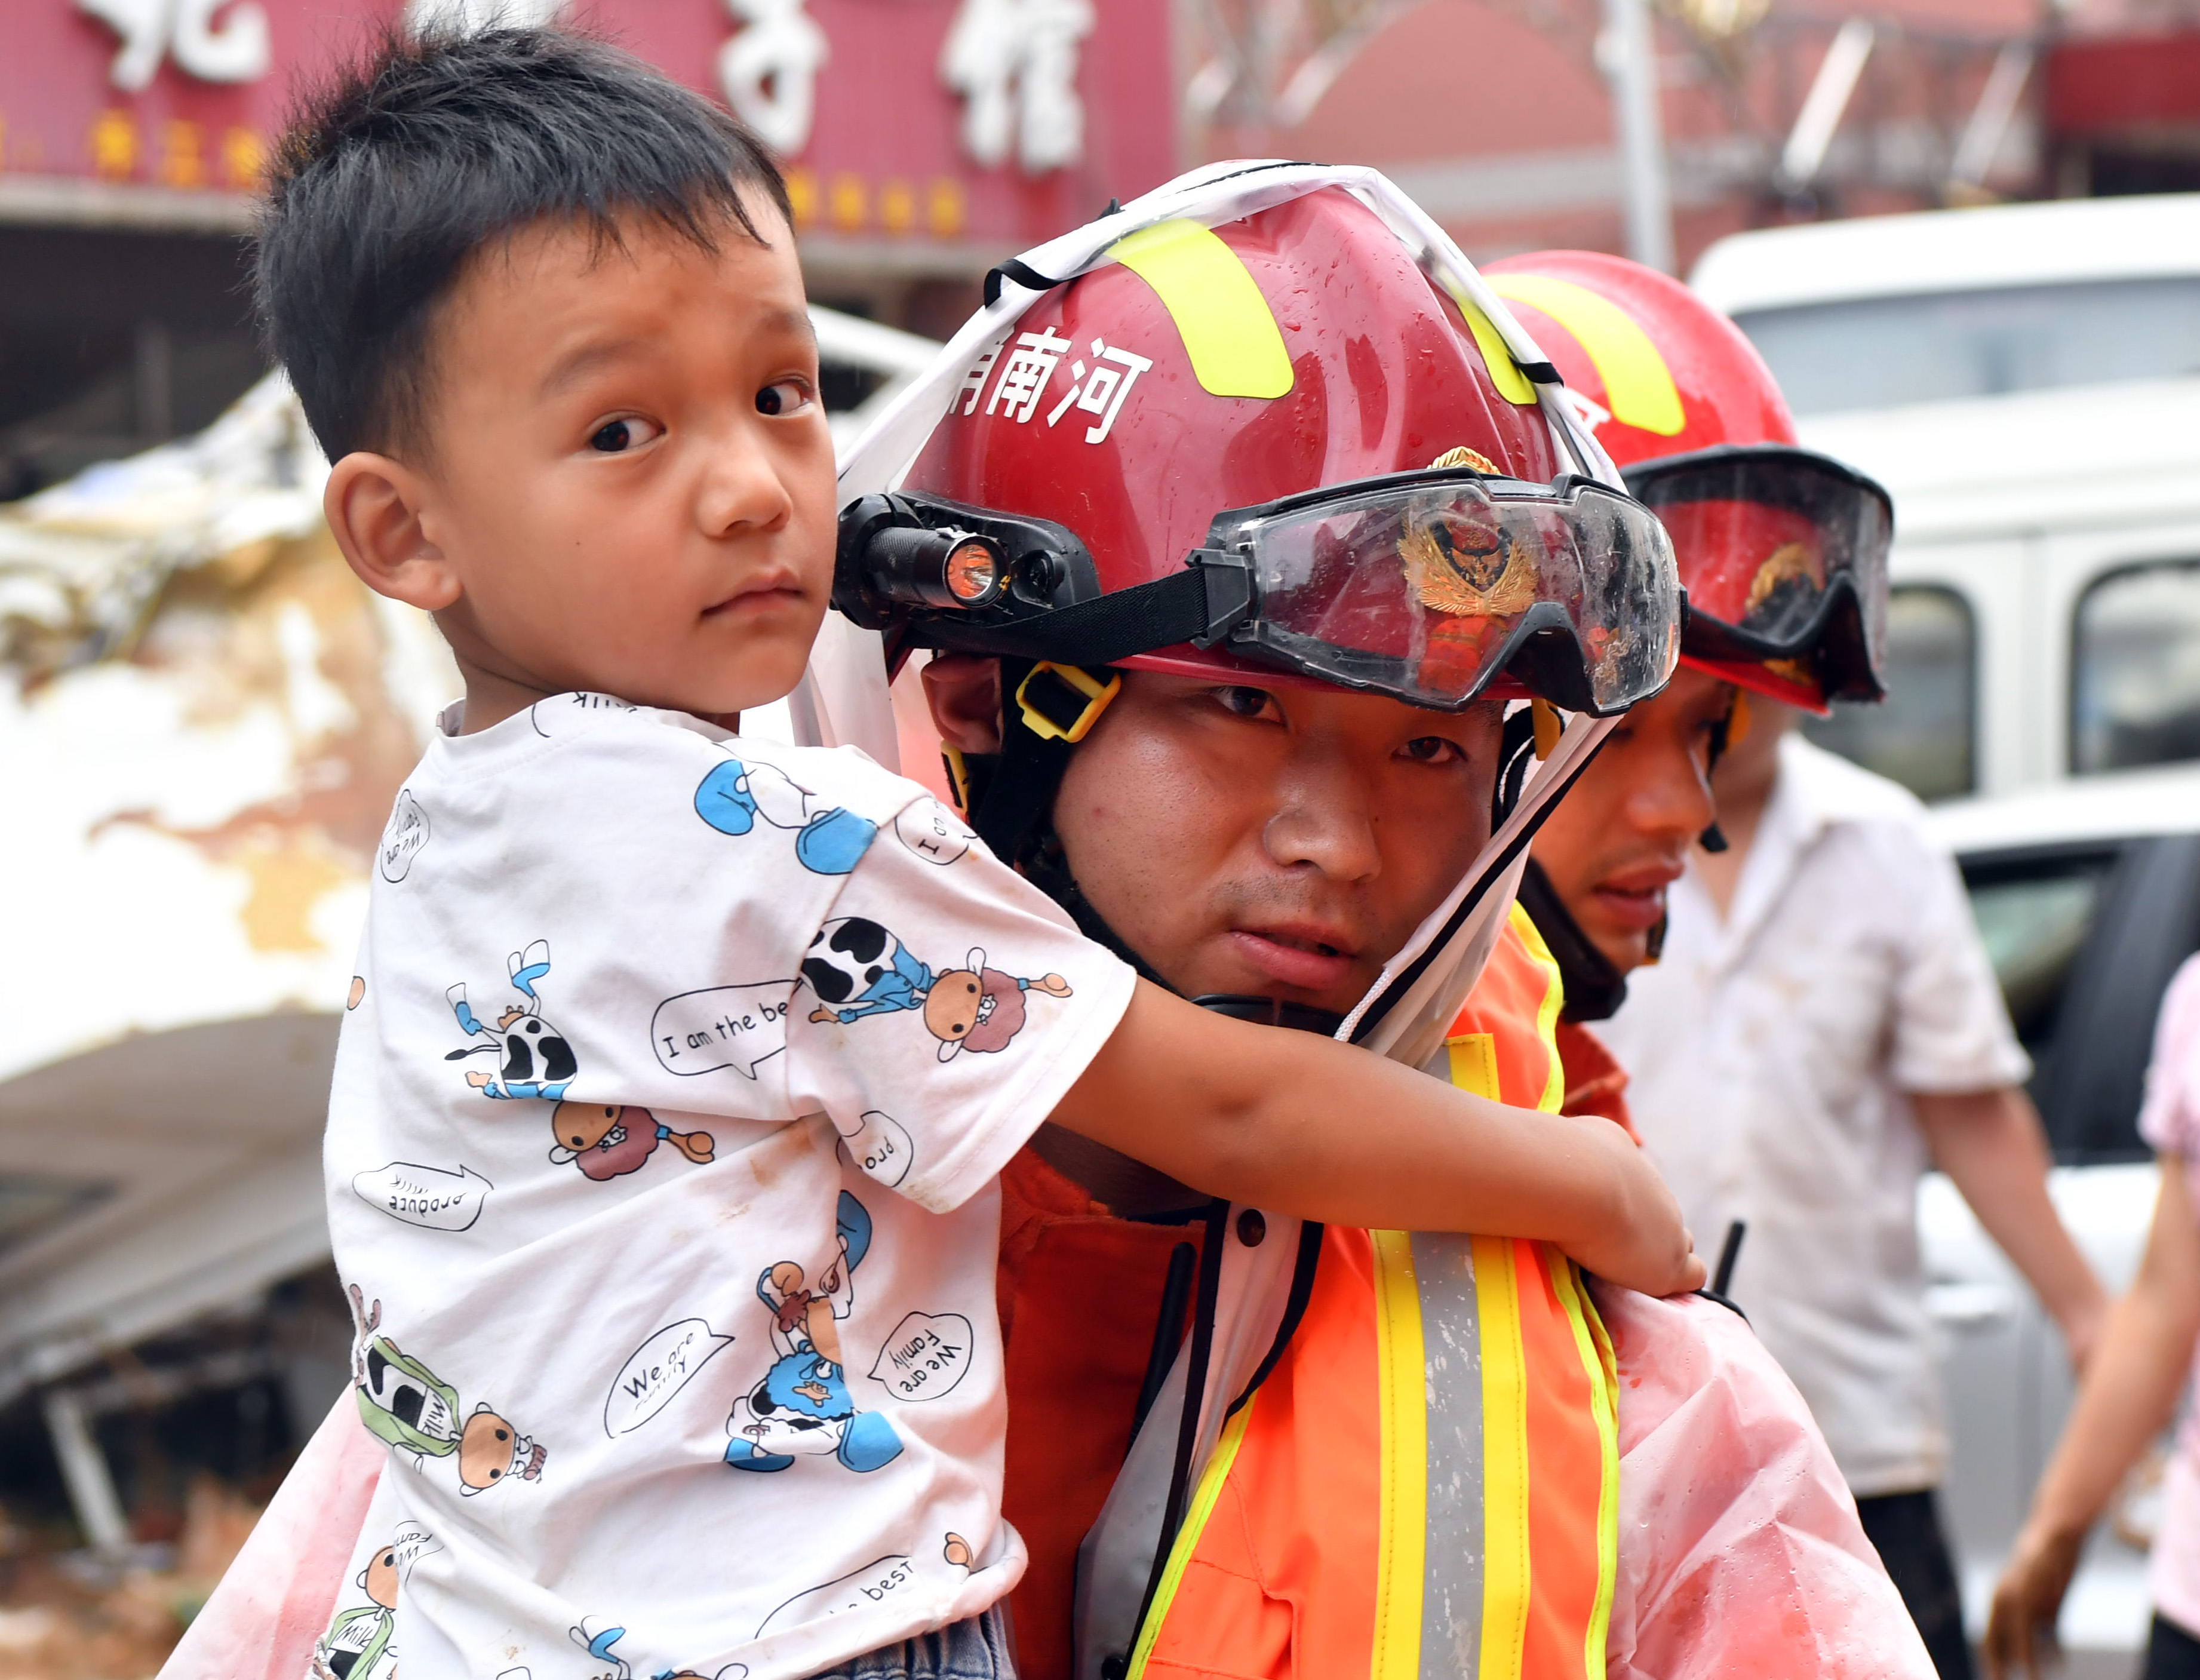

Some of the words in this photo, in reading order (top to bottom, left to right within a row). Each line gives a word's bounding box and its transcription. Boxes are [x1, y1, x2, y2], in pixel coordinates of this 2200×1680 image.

[918, 839, 940, 855] I
[662, 1036, 680, 1058] I
[687, 1031, 714, 1049] am
[715, 1015, 757, 1040] the
[389, 1192, 468, 1218] produce
[889, 1328, 941, 1369] Family
[926, 1345, 963, 1370] We
[623, 1366, 663, 1399] We
[668, 1332, 696, 1365] are
[899, 1369, 927, 1392] are
[422, 1393, 446, 1436] Milk
[859, 1561, 914, 1601] best
[336, 1625, 373, 1647] Milk
